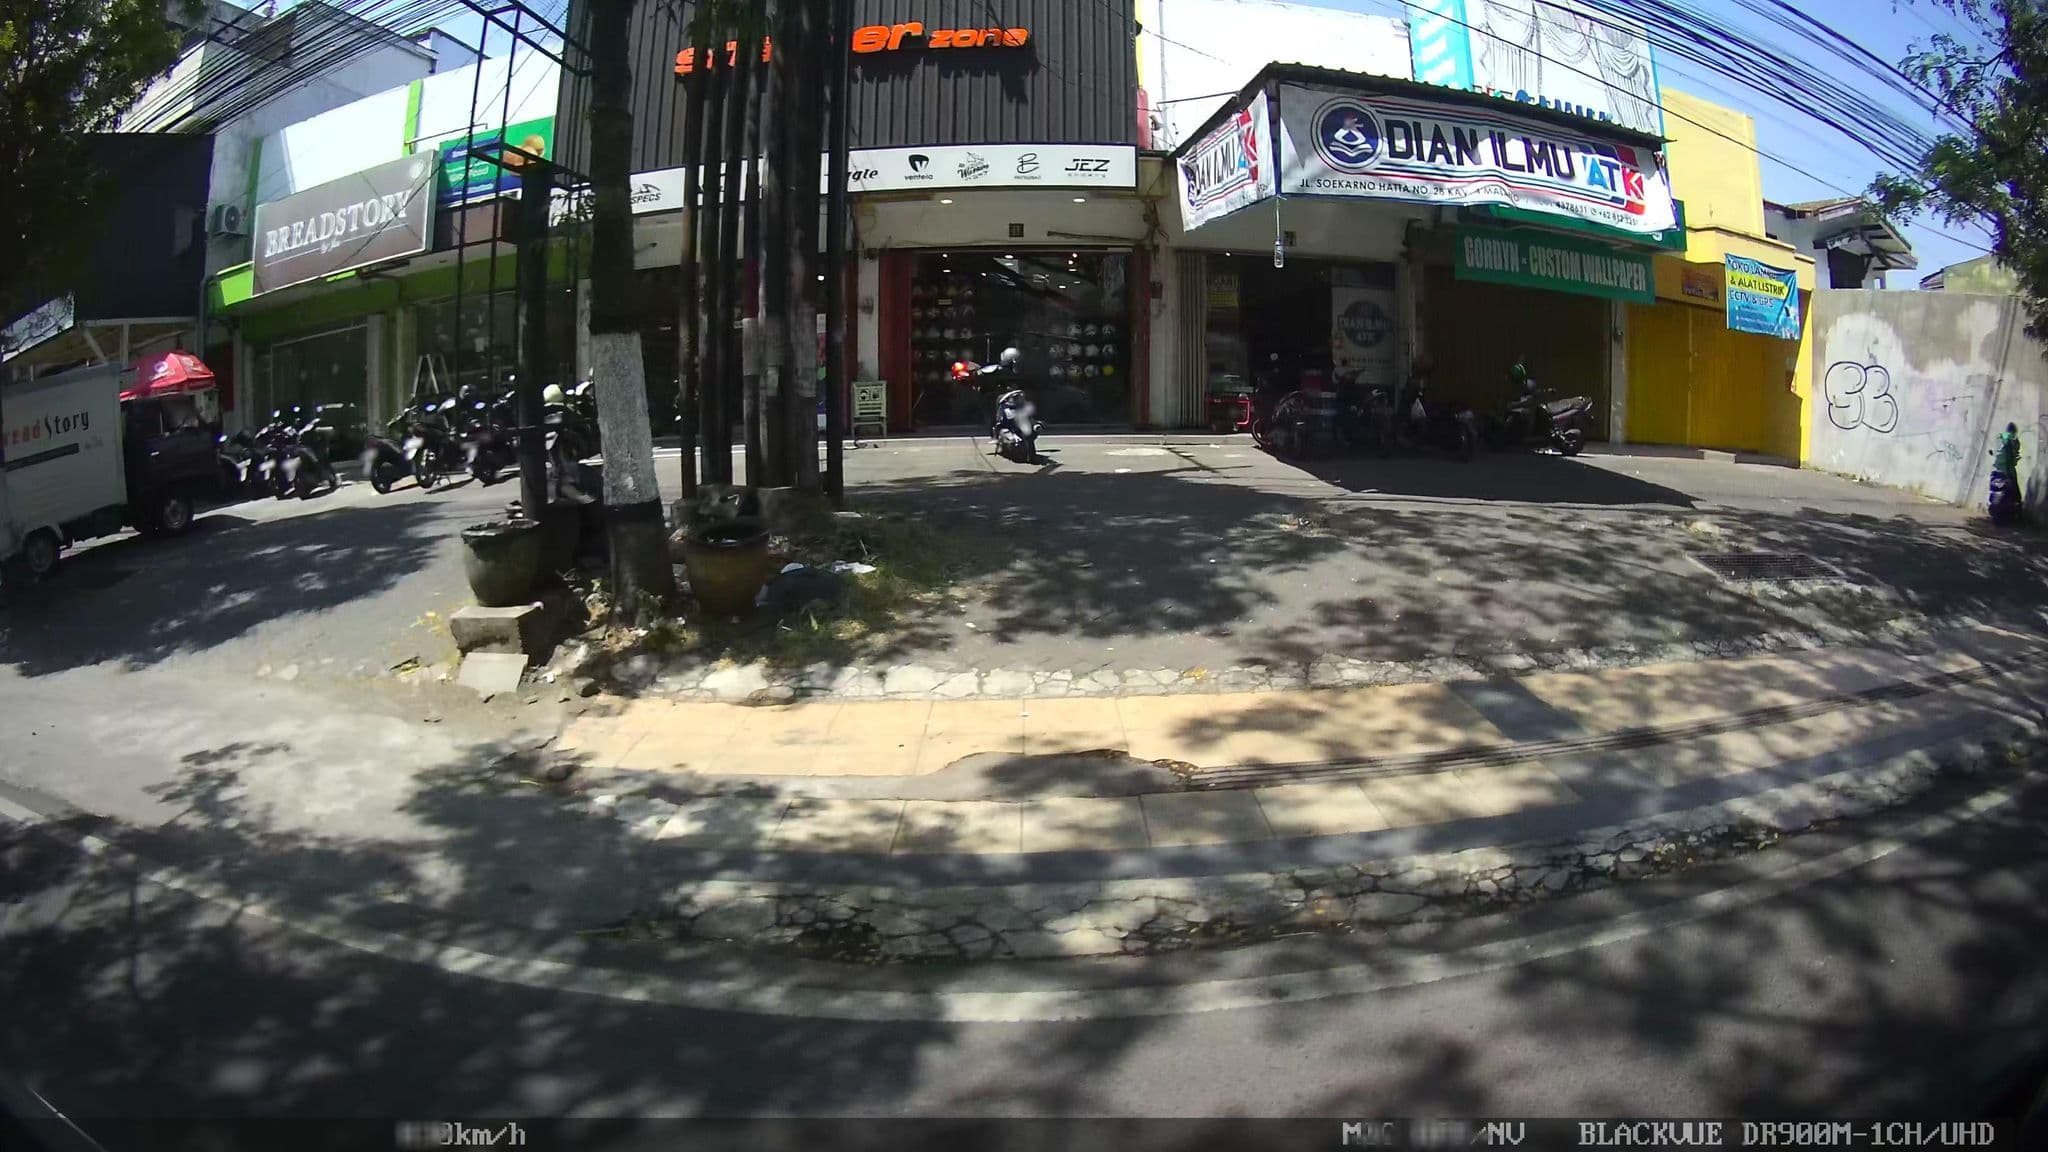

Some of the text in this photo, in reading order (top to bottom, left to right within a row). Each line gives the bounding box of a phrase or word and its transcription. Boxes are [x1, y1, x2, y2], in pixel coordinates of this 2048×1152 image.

[929, 27, 1028, 48] zone
[1065, 158, 1110, 172] JEZ
[1384, 119, 1645, 200] DIAN ILMU ATK
[1317, 178, 1376, 191] SOEKARNO
[264, 189, 412, 258] BREADSTORY
[1529, 245, 1581, 280] CUSTOM
[1582, 252, 1647, 291] WALLPAPER
[1738, 277, 1757, 290] ALAT
[44, 411, 89, 440] Story
